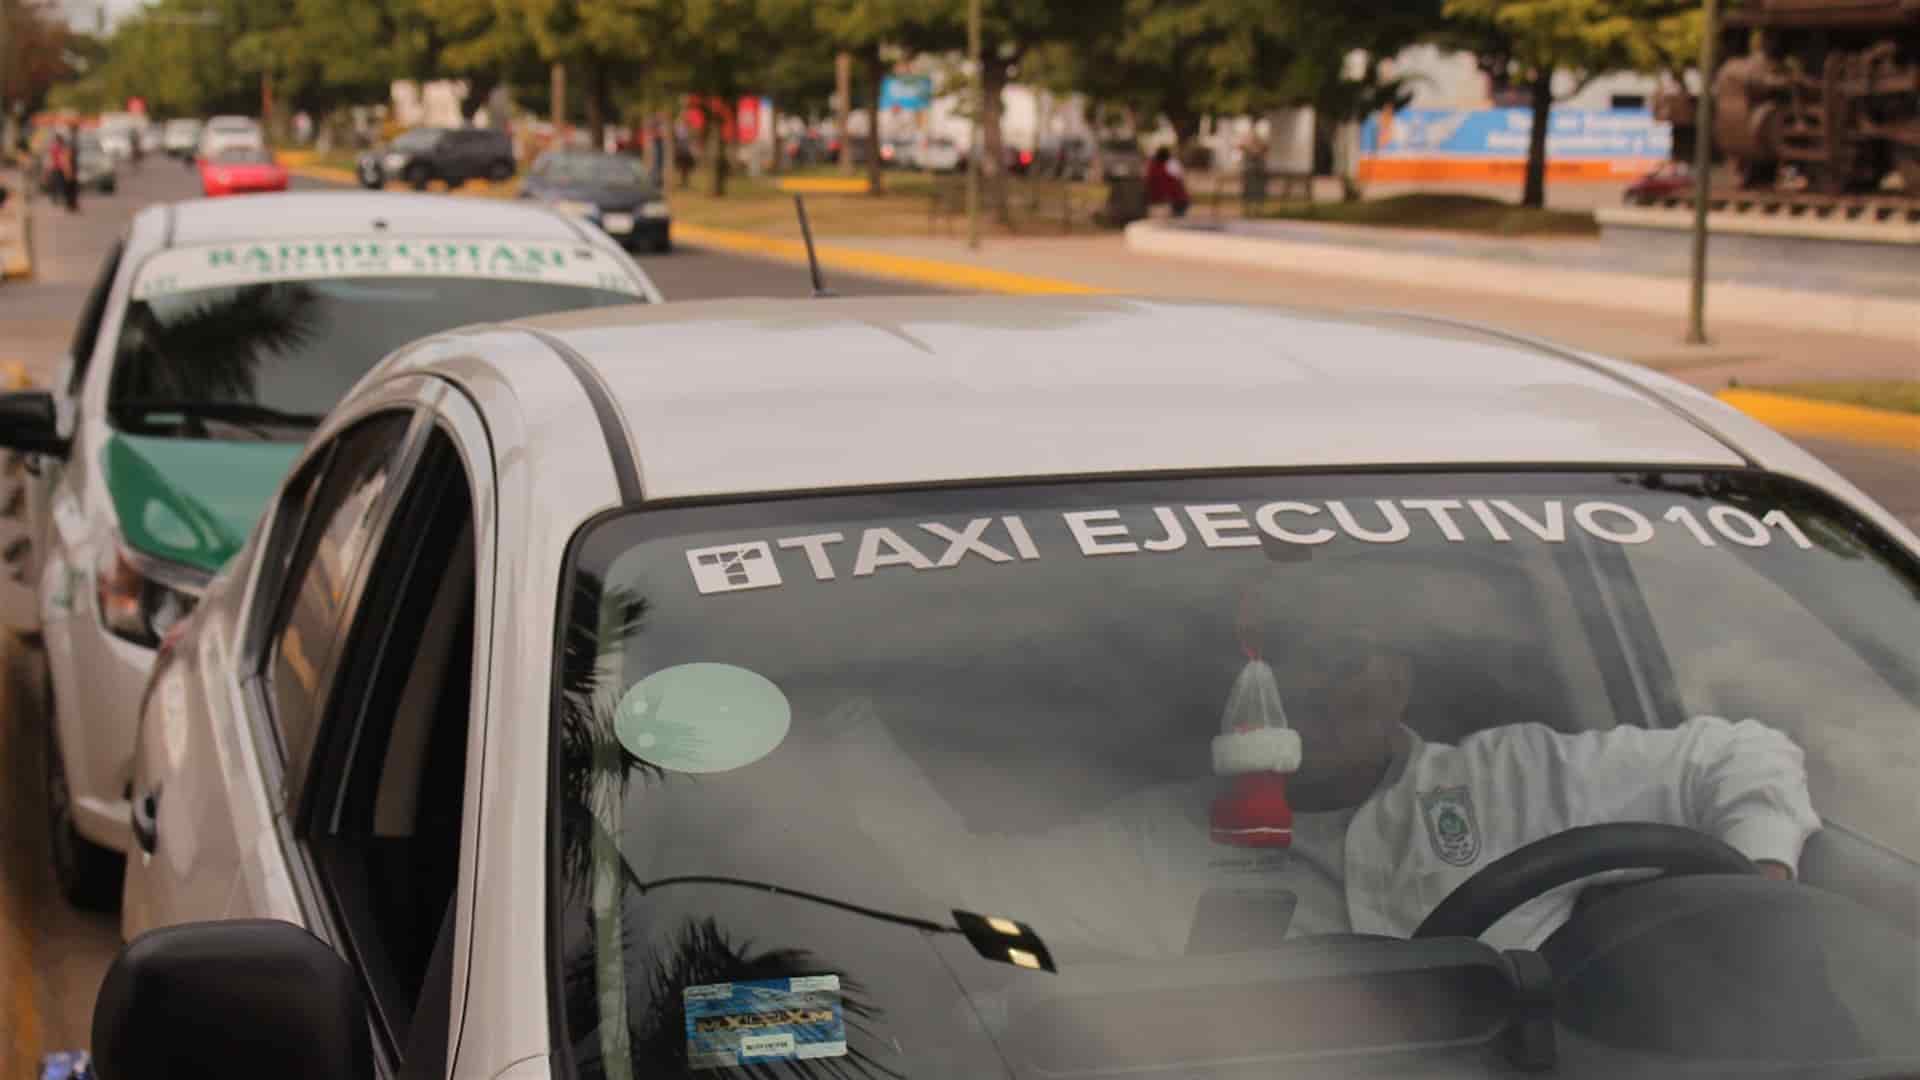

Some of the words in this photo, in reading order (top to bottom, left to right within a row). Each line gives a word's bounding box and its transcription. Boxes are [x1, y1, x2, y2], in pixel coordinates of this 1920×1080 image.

[207, 243, 567, 269] RADIOECOTAXI
[778, 514, 1040, 582] TAXI
[1063, 499, 1655, 556] EJECUTIVO
[1663, 504, 1814, 550] 101
